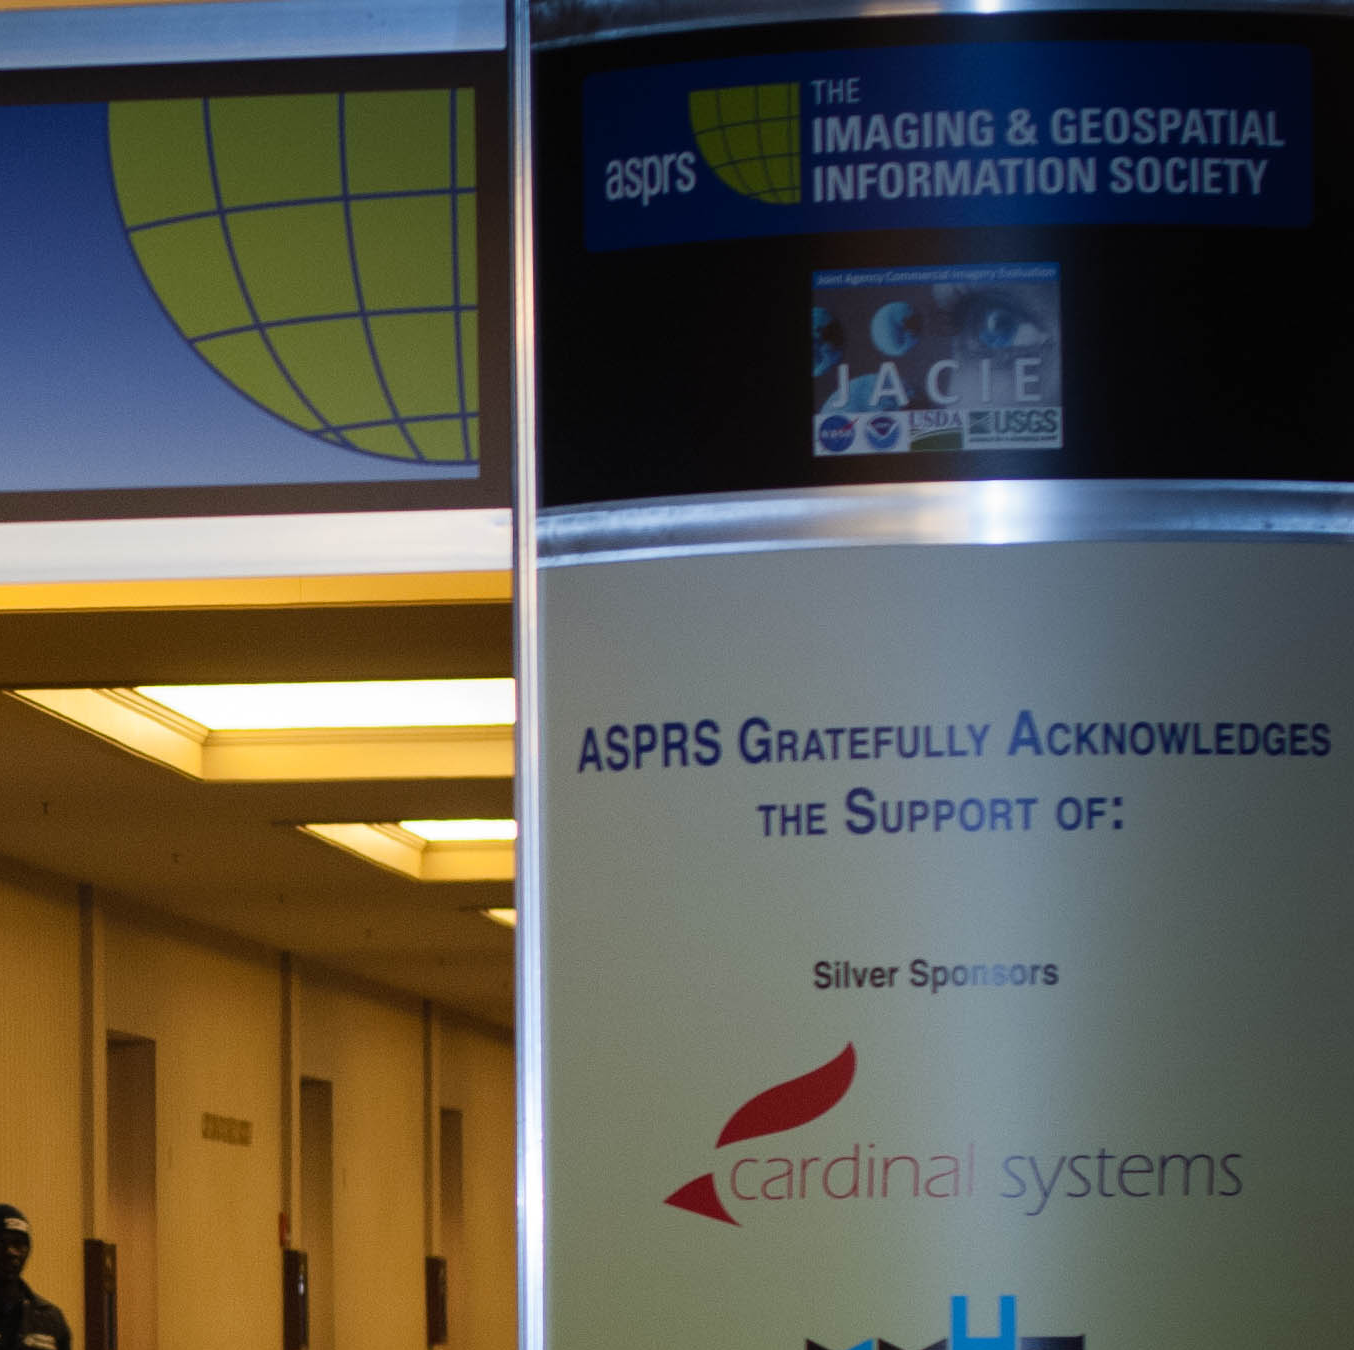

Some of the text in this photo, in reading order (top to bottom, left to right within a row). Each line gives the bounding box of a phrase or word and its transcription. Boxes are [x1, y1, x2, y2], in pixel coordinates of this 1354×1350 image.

[811, 78, 861, 105] THE
[812, 107, 1284, 154] IMAGING & GEOSPATIAL
[606, 151, 696, 207] asprs
[812, 157, 1267, 203] INFORMATION SOCIETY
[994, 408, 1058, 434] USGS
[578, 719, 721, 774] ASPRS
[812, 960, 1059, 994] Silver Sponsors
[729, 1143, 1243, 1217] cardinal systems
